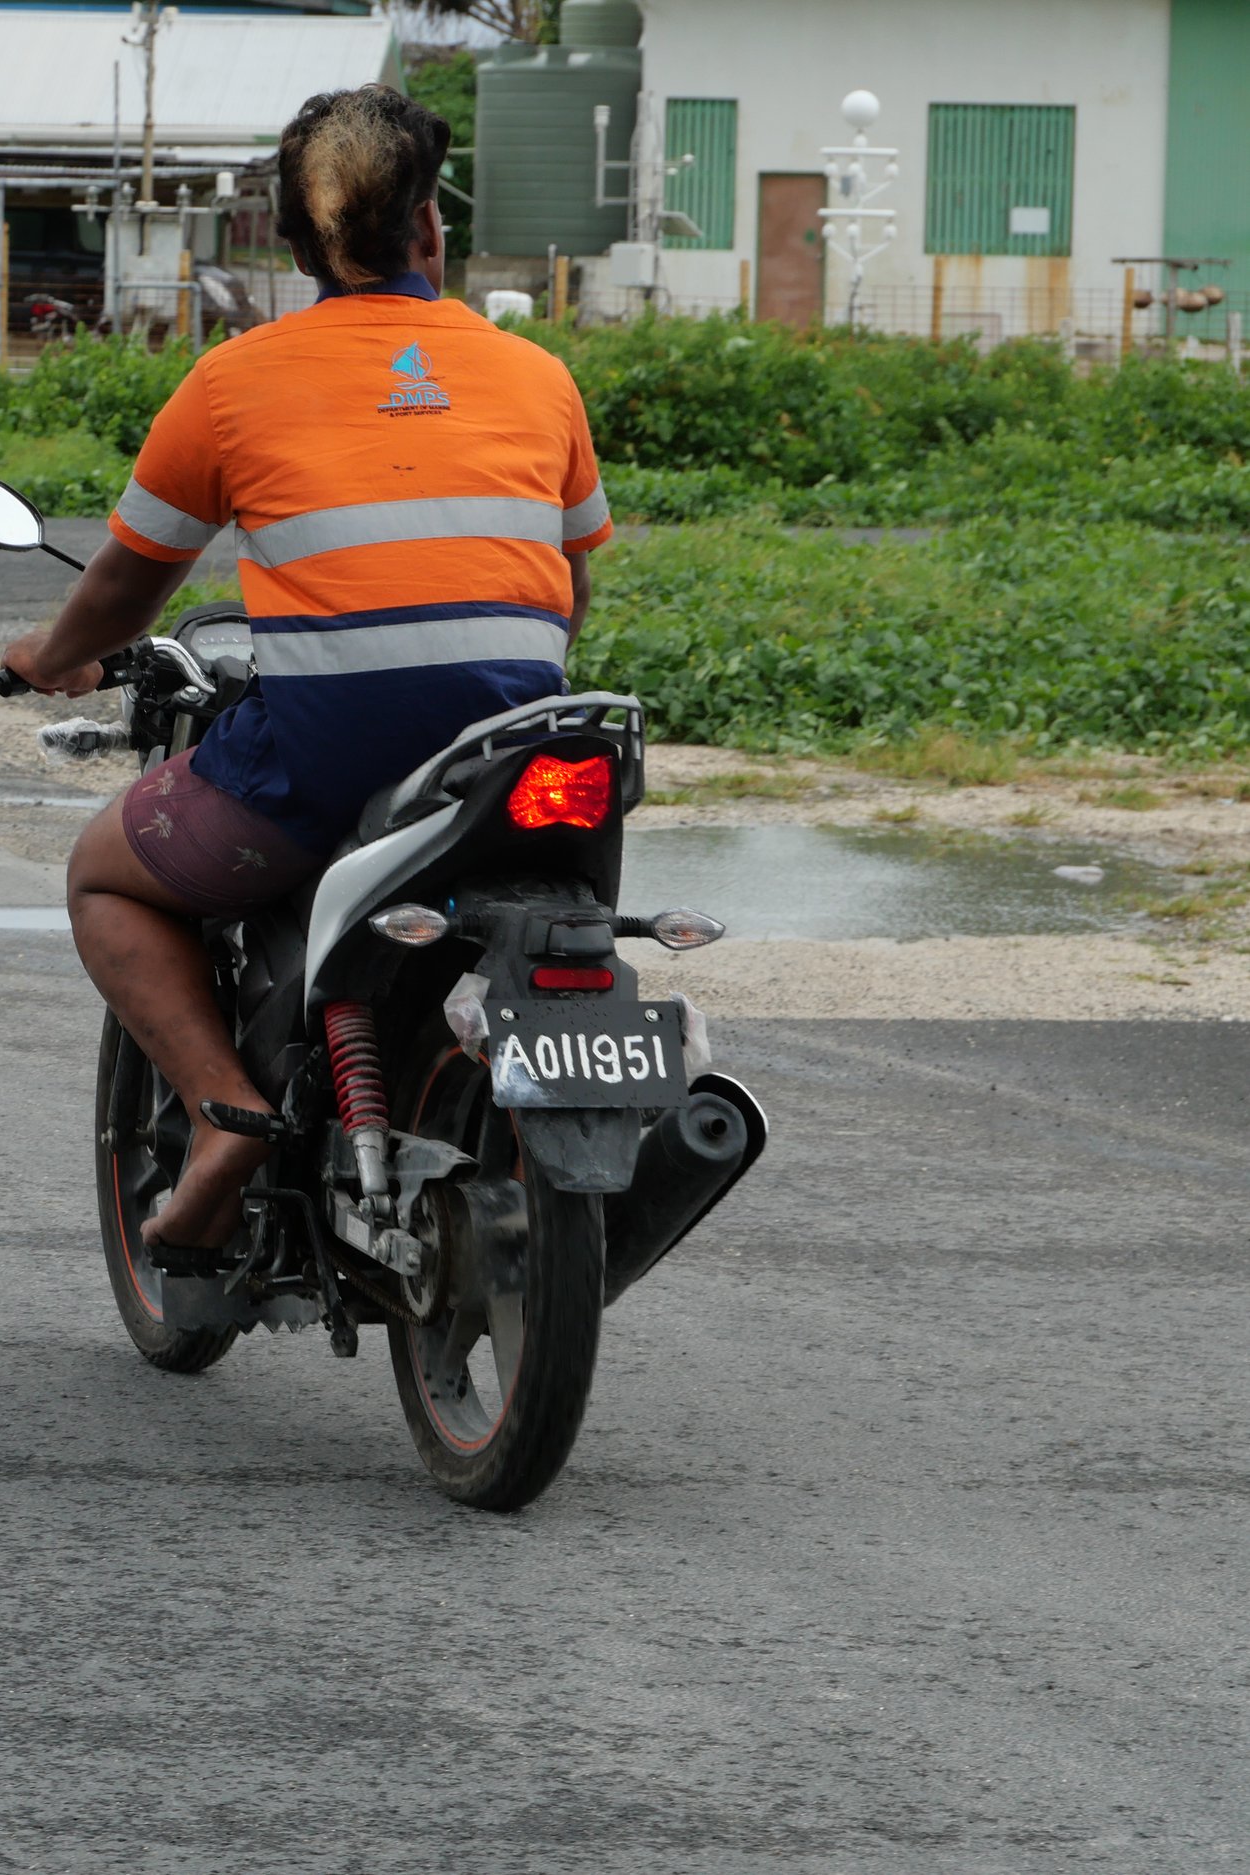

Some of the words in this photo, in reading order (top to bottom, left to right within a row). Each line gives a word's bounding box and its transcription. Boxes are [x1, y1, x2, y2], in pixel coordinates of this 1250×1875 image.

[389, 391, 450, 407] DMPS
[377, 405, 419, 414] DEPARTMENT
[498, 1032, 667, 1083] A011951
